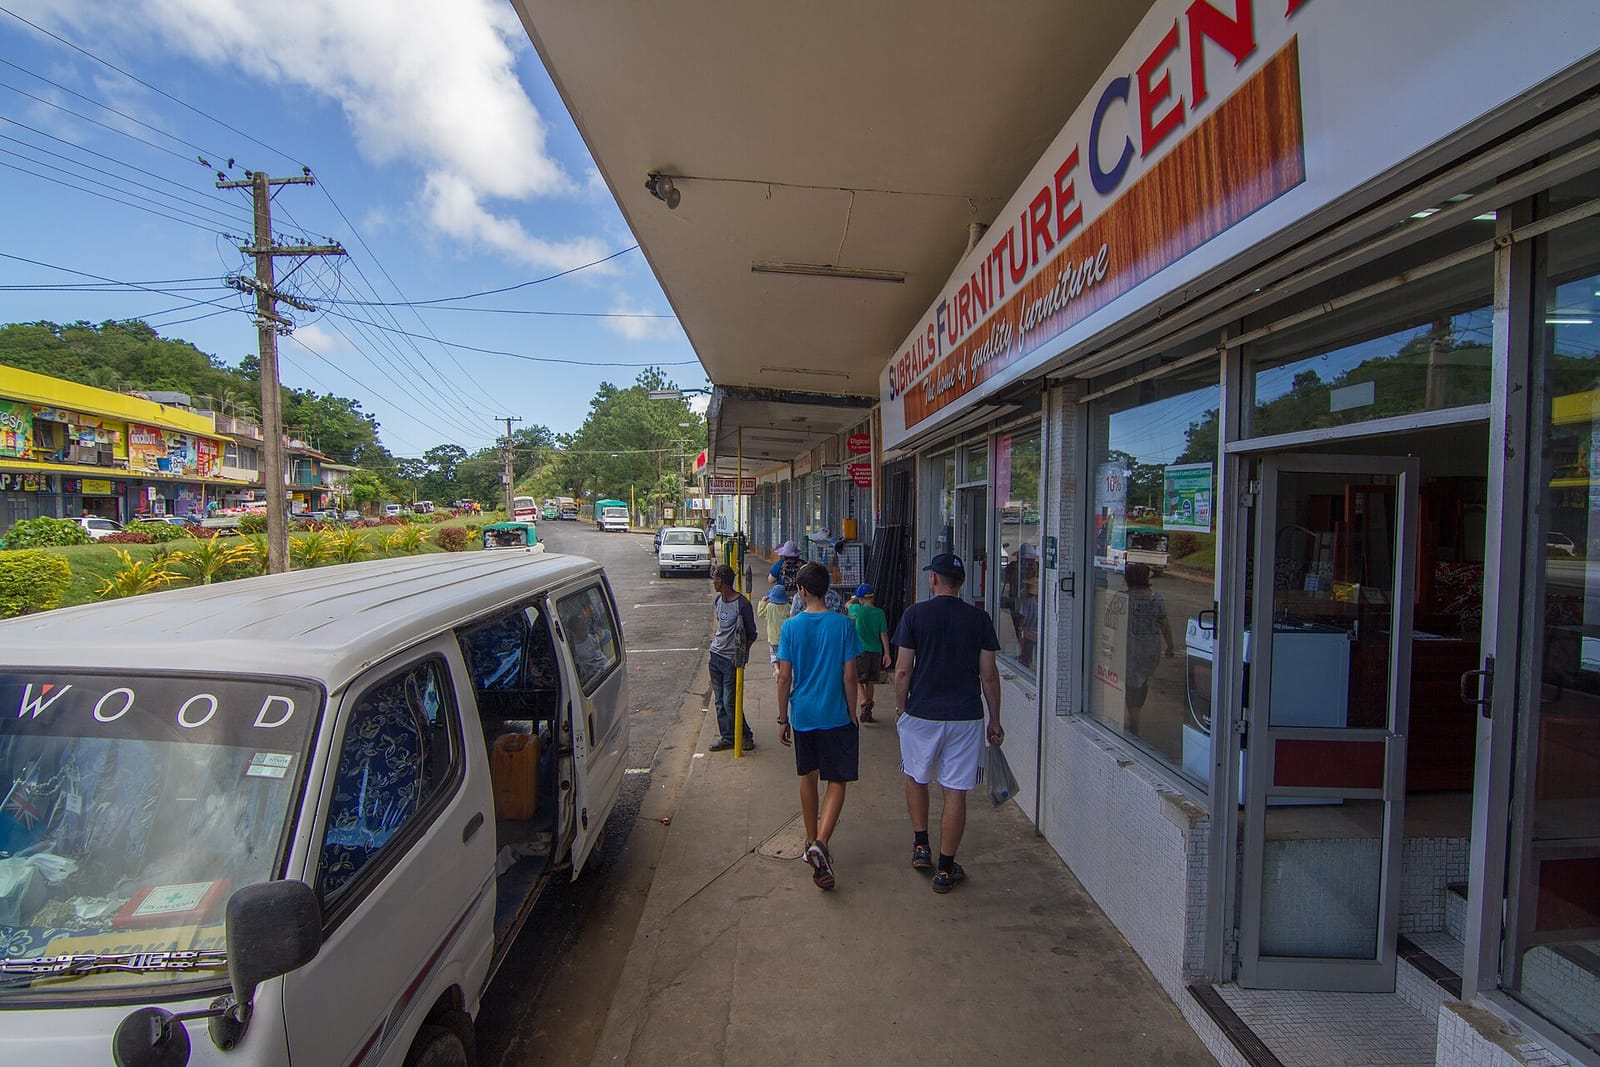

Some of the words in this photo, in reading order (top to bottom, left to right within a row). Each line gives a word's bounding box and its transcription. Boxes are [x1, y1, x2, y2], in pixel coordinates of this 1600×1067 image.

[888, 322, 936, 401] SUBRAILS
[936, 142, 1083, 357] FURNITURE
[1088, 0, 1313, 196] CEN
[923, 374, 936, 406] The
[937, 366, 955, 395] home
[958, 345, 967, 390] of
[971, 317, 1014, 385] quality
[1018, 243, 1109, 353] furniture
[0, 411, 23, 432] esh
[16, 683, 295, 728] WOOD
